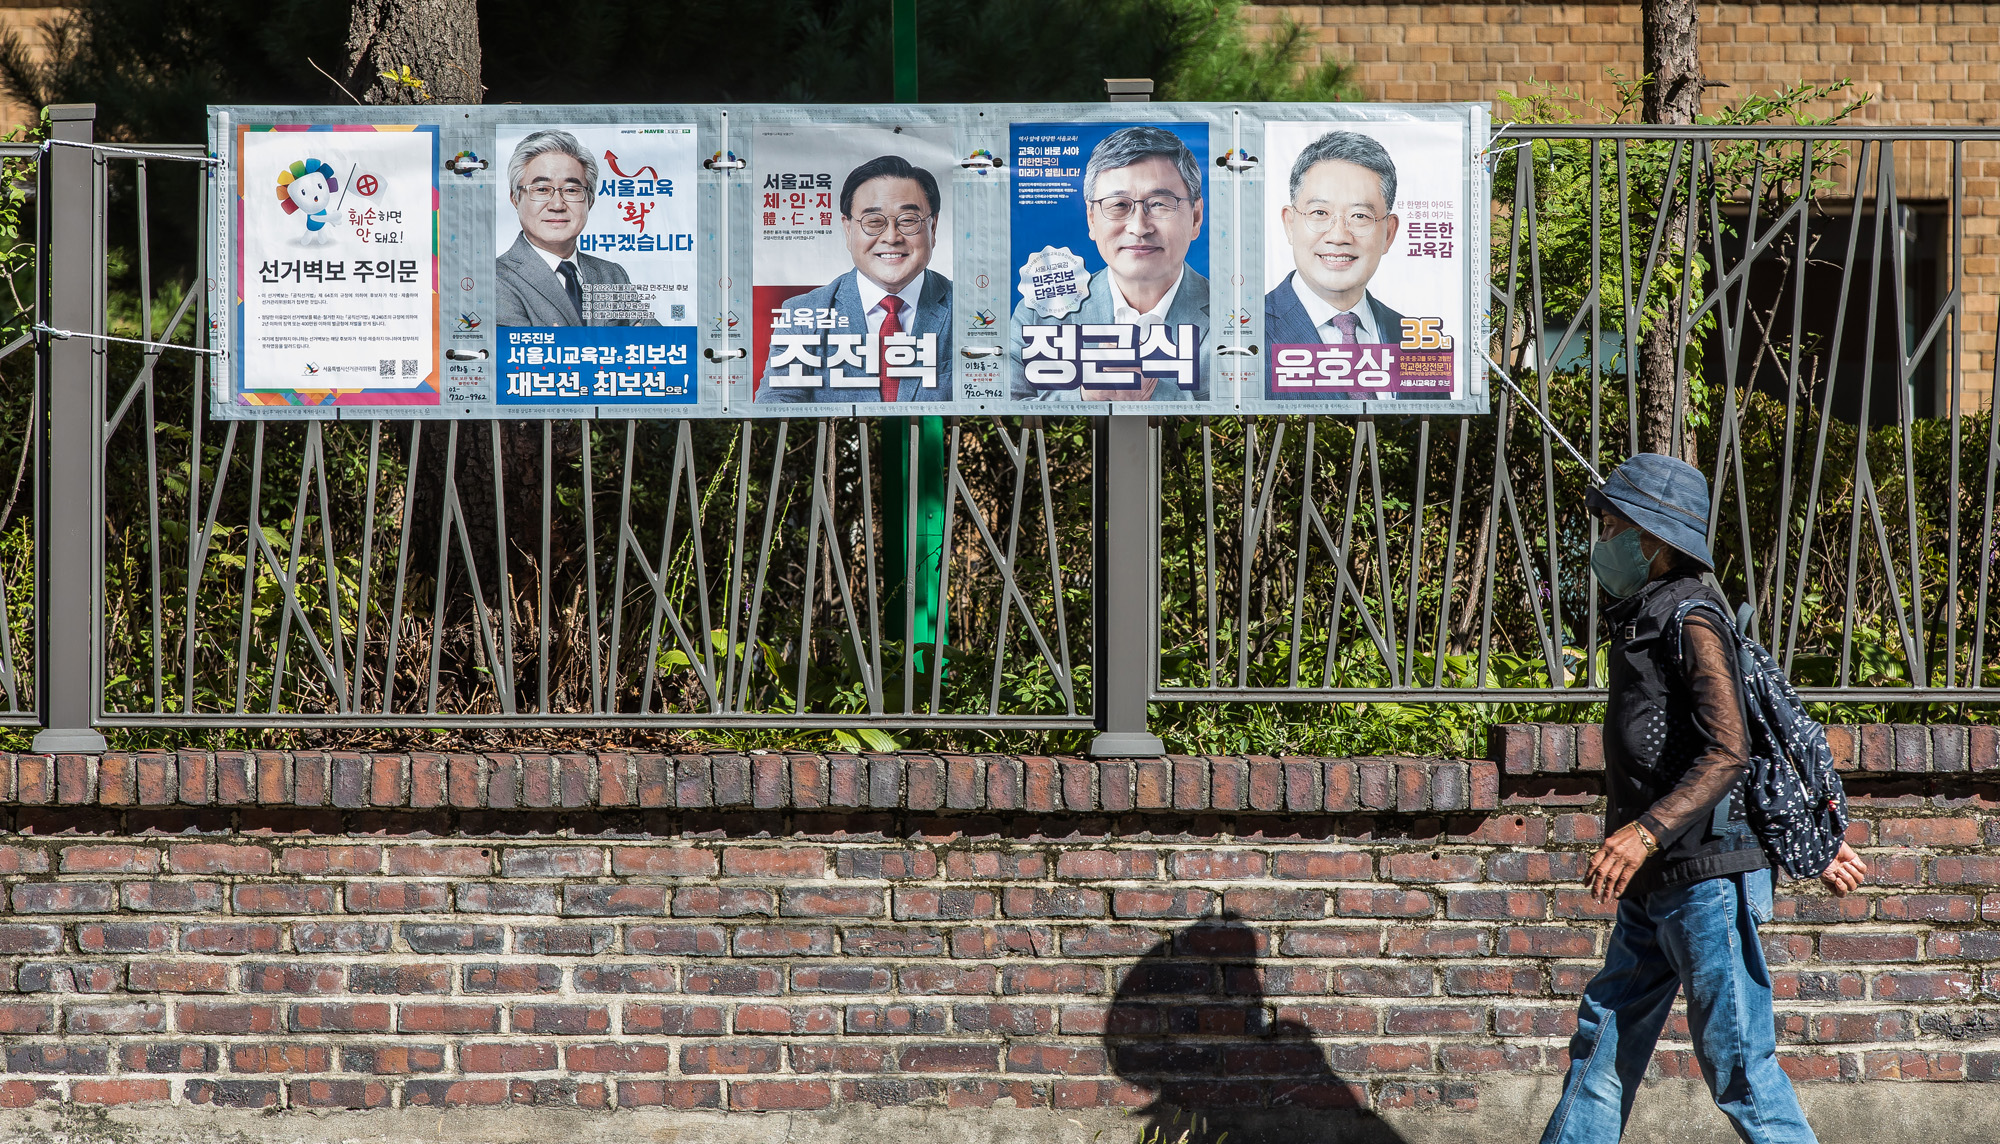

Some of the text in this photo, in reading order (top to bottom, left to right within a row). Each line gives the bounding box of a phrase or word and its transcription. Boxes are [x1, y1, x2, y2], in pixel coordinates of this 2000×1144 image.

[1018, 146, 1080, 156] 교육이 바로 서야
[1018, 157, 1059, 167] 대한민국의
[1018, 168, 1080, 177] 미래가 열립니다!
[598, 178, 674, 198] 서울교육
[763, 173, 832, 190] 서울교육
[1397, 200, 1454, 210] 단 한명의 아이도
[348, 207, 402, 226] 훼손하면
[1406, 211, 1454, 219] 소중히 여기는
[356, 228, 403, 244] 안 돼요!
[1407, 222, 1454, 239] 든든한
[580, 233, 694, 252] 바꾸겠습니다
[1407, 241, 1454, 258] 교육감
[259, 259, 418, 283] 선거벽보 주의문
[1035, 261, 1069, 274] 서울시교육감
[1032, 270, 1076, 288] 민주진보
[593, 284, 611, 292] 2022
[650, 284, 675, 292] 민주진보
[677, 284, 689, 292] 후보
[1034, 283, 1078, 301] 단일후보
[770, 307, 849, 329] 교육감은
[509, 332, 556, 344] 민주진보
[625, 344, 687, 365] 최보선
[768, 332, 937, 388] 조전혁
[1021, 323, 1198, 389] 정근식
[1275, 347, 1395, 387] 윤호상
[1400, 362, 1453, 372] 학교현장전문가
[506, 370, 690, 397] 재보선은 최보선으로!
[1400, 379, 1451, 387] 서울시교육감 후보
[449, 393, 487, 401] 720-9962
[965, 389, 1003, 399] 720-9962
